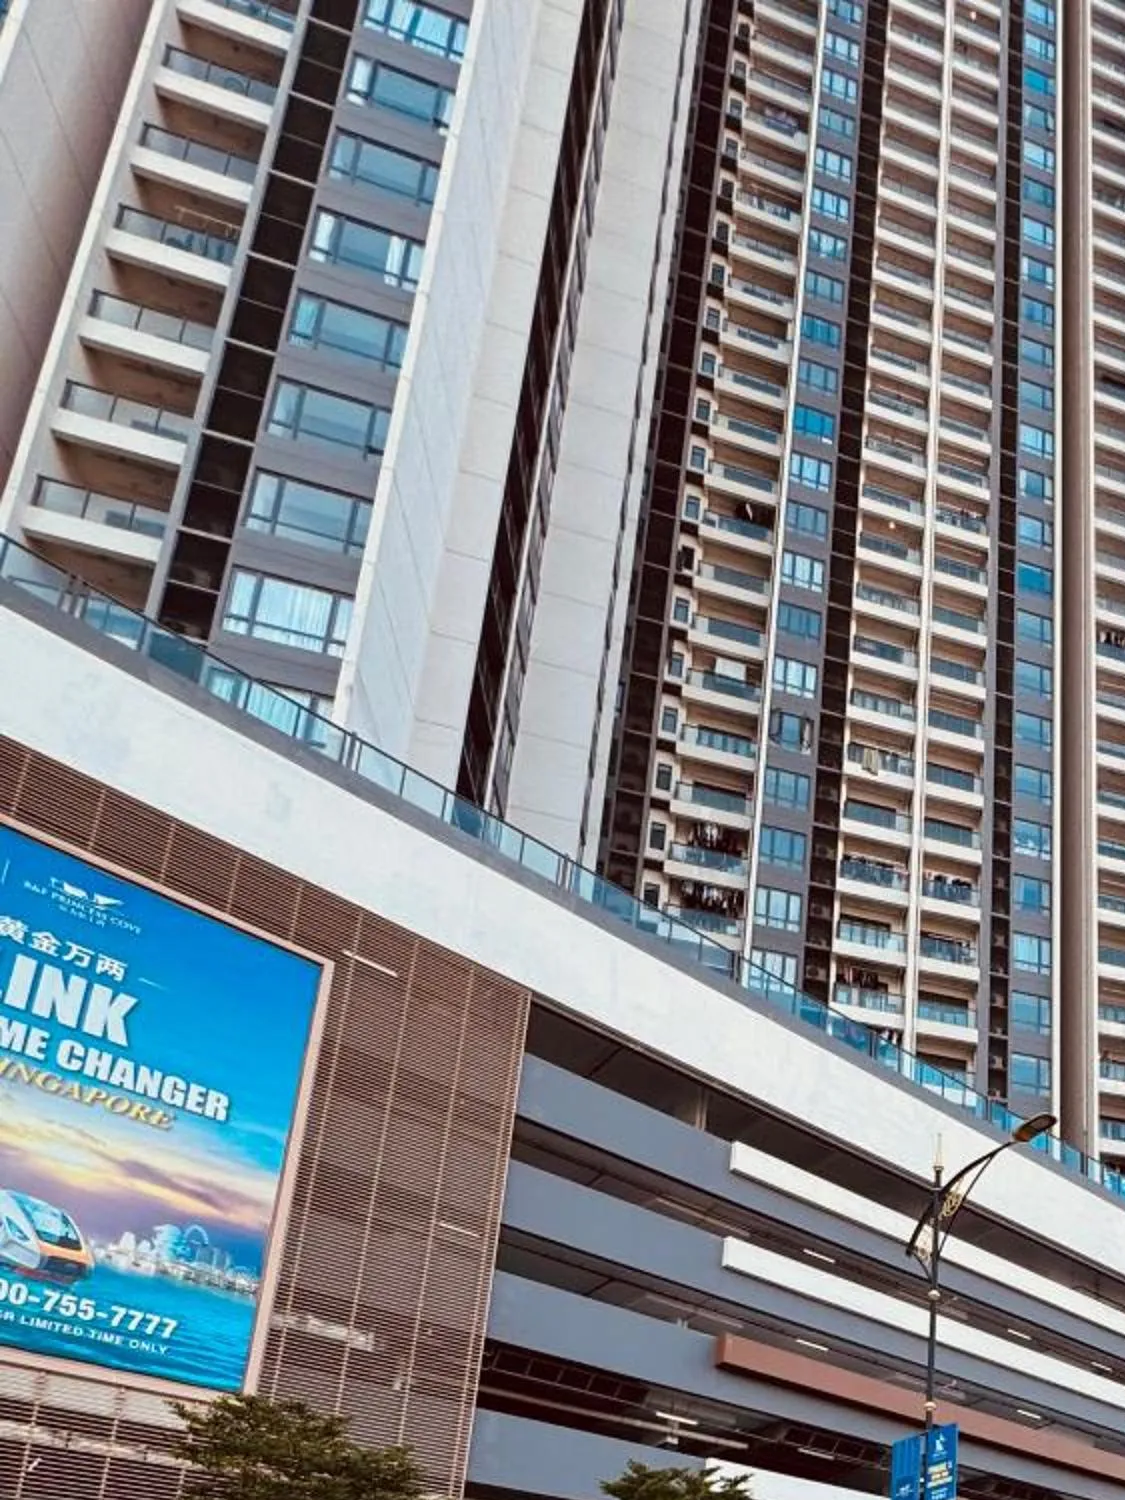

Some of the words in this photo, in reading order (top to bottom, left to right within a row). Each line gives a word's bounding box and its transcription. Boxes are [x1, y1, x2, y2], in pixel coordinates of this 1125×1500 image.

[0, 915, 128, 981] 黄金万两
[0, 953, 138, 1047] INK
[56, 1038, 229, 1121] CHANGER
[20, 1315, 83, 1336] LIMITED
[87, 1328, 124, 1346] TIME
[129, 1338, 170, 1355] ONLY
